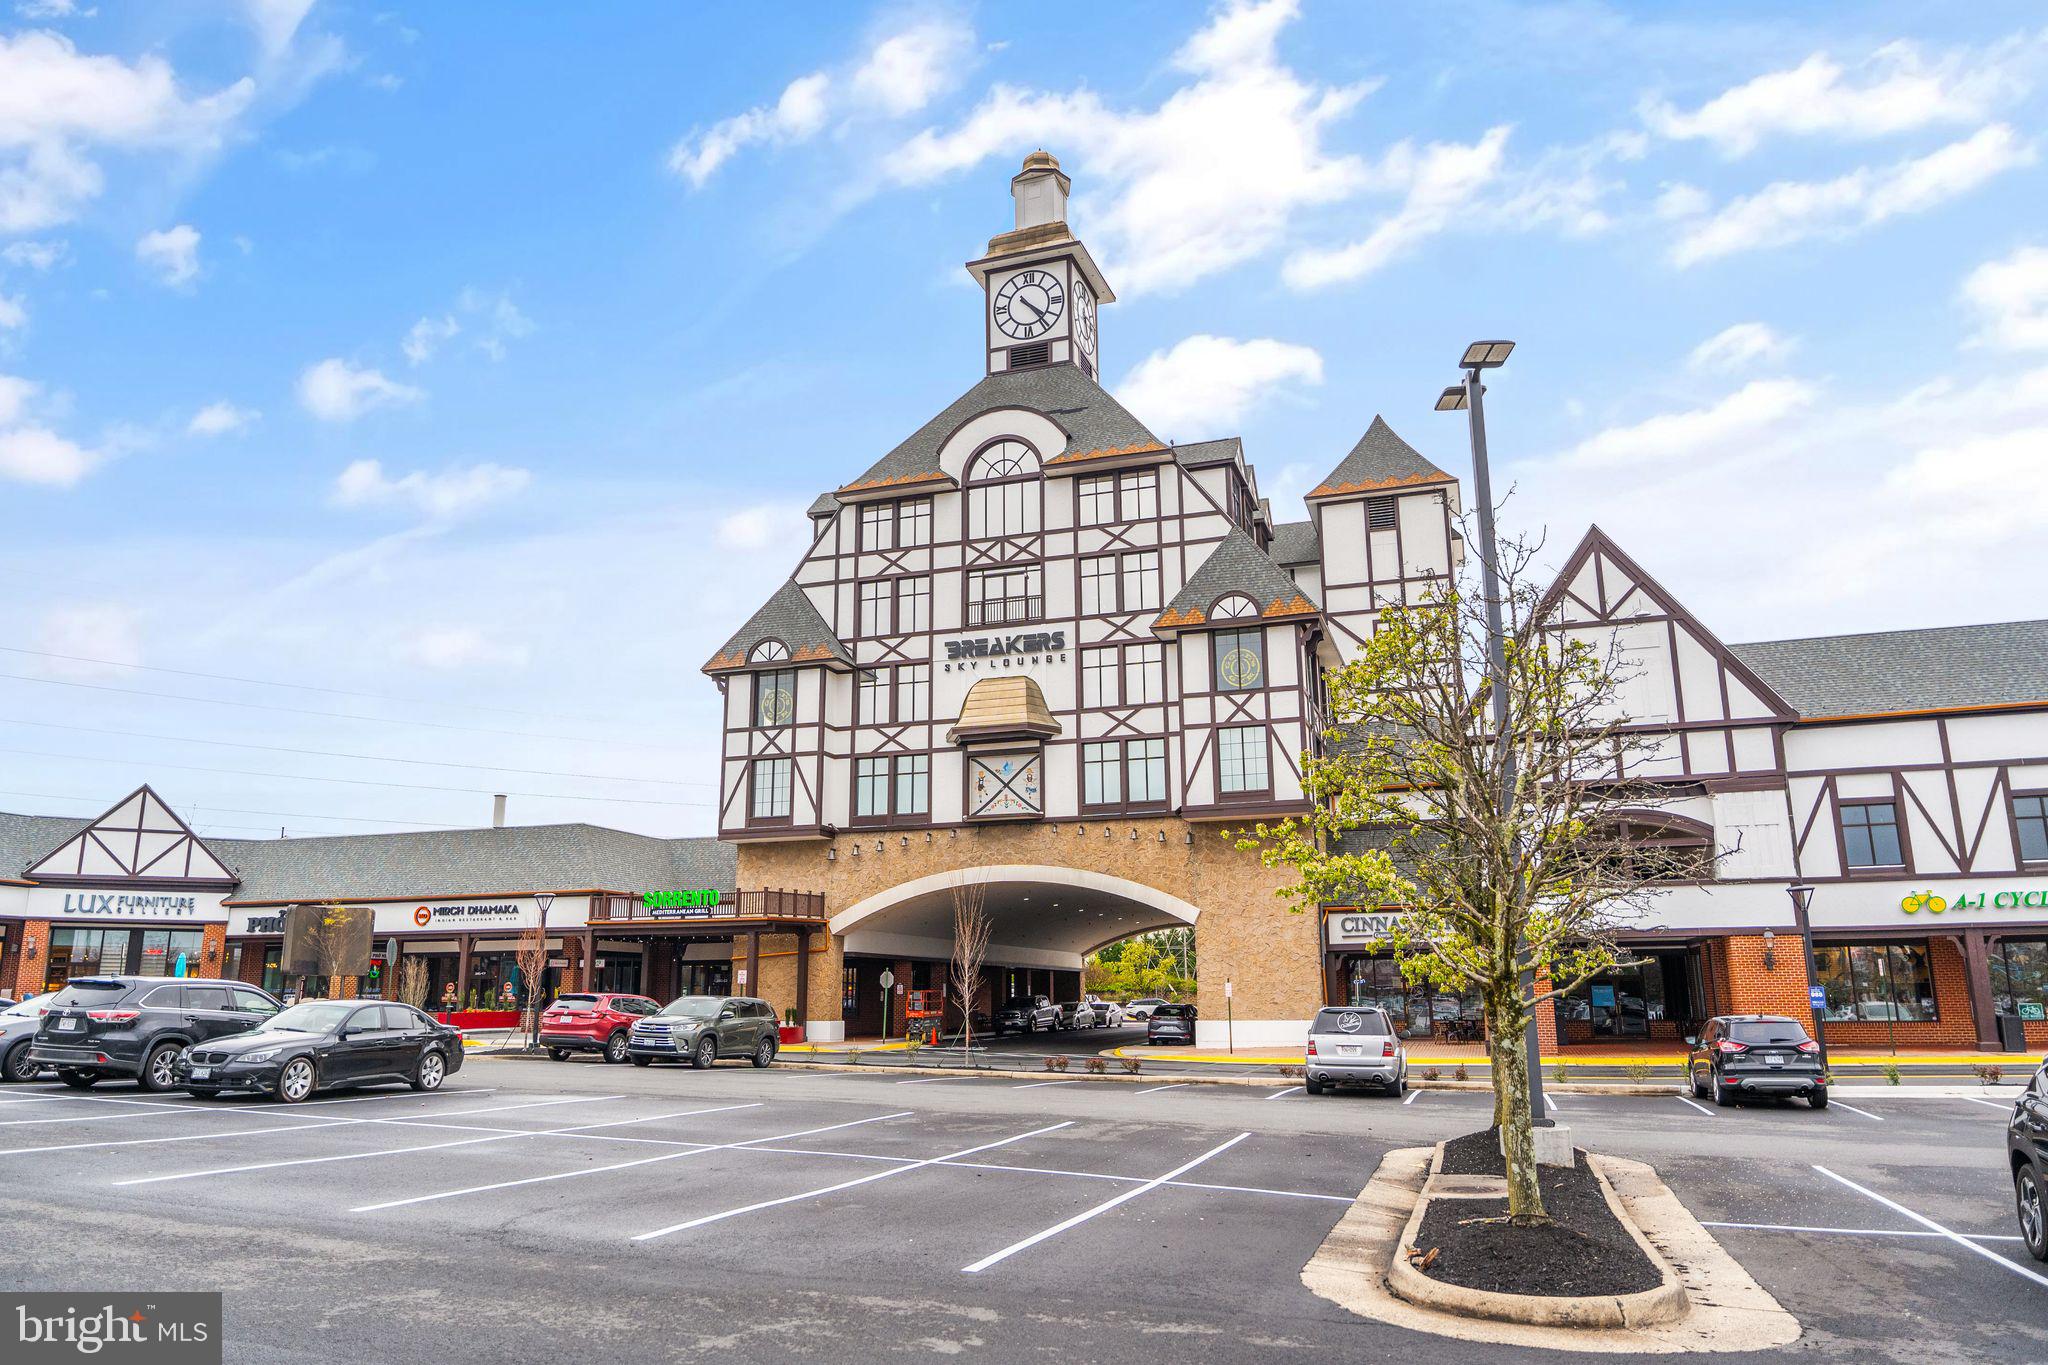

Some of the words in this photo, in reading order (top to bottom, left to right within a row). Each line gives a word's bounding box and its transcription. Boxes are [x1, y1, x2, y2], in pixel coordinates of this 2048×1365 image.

[1023, 272, 1034, 284] XII
[945, 631, 1064, 659] BREAKERS
[944, 661, 977, 672] SKY
[990, 653, 1066, 668] LOUNGE
[63, 893, 115, 914] LUX
[117, 896, 195, 908] FURNITURE
[643, 889, 720, 908] SORRENTO
[1952, 892, 1986, 910] A-1
[116, 907, 195, 915] GALLERY
[433, 906, 464, 916] MIRCH
[467, 904, 519, 915] DHAMAKA
